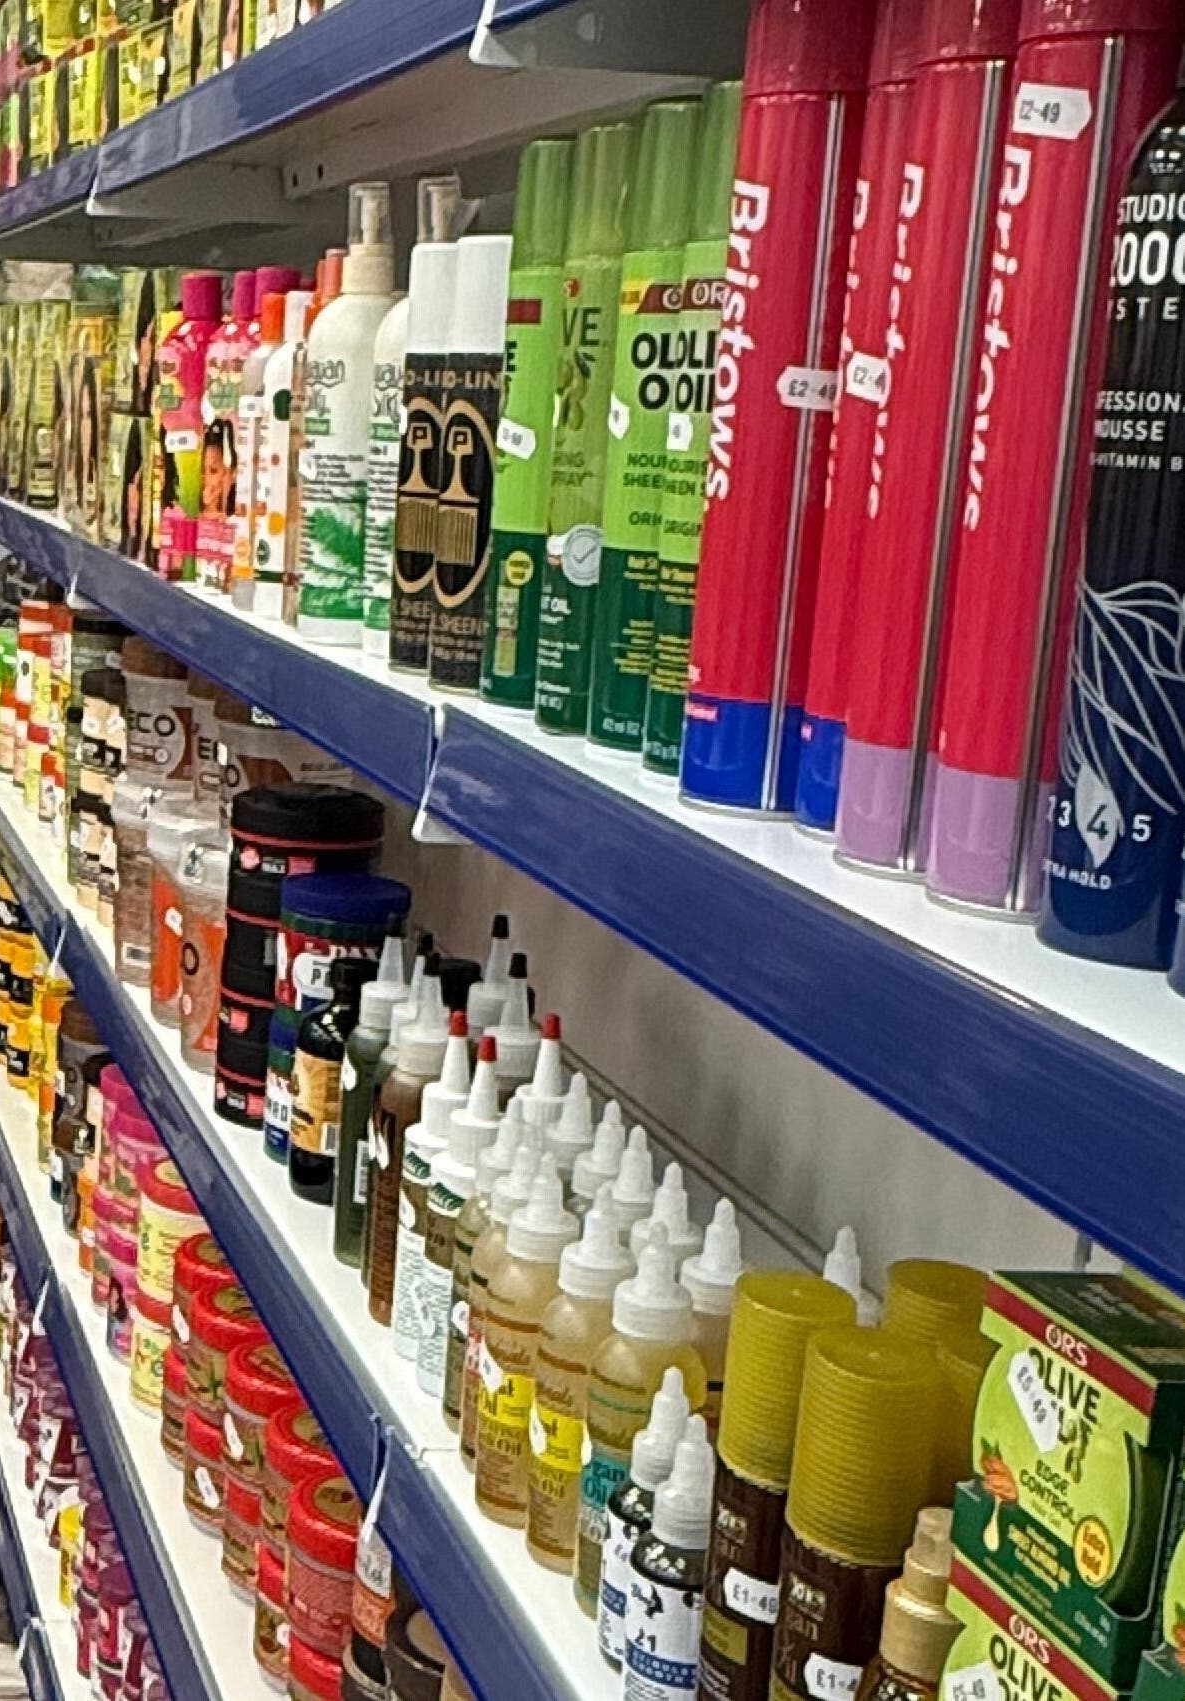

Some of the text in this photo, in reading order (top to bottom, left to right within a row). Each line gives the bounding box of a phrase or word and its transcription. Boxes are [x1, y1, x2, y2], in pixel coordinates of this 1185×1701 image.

[691, 282, 730, 306] OR
[706, 177, 770, 501] Bristows
[1095, 391, 1185, 413] FESSION
[1058, 800, 1152, 842] 3 4 5
[1044, 1322, 1089, 1367] ORS
[1007, 1613, 1051, 1655] ORS
